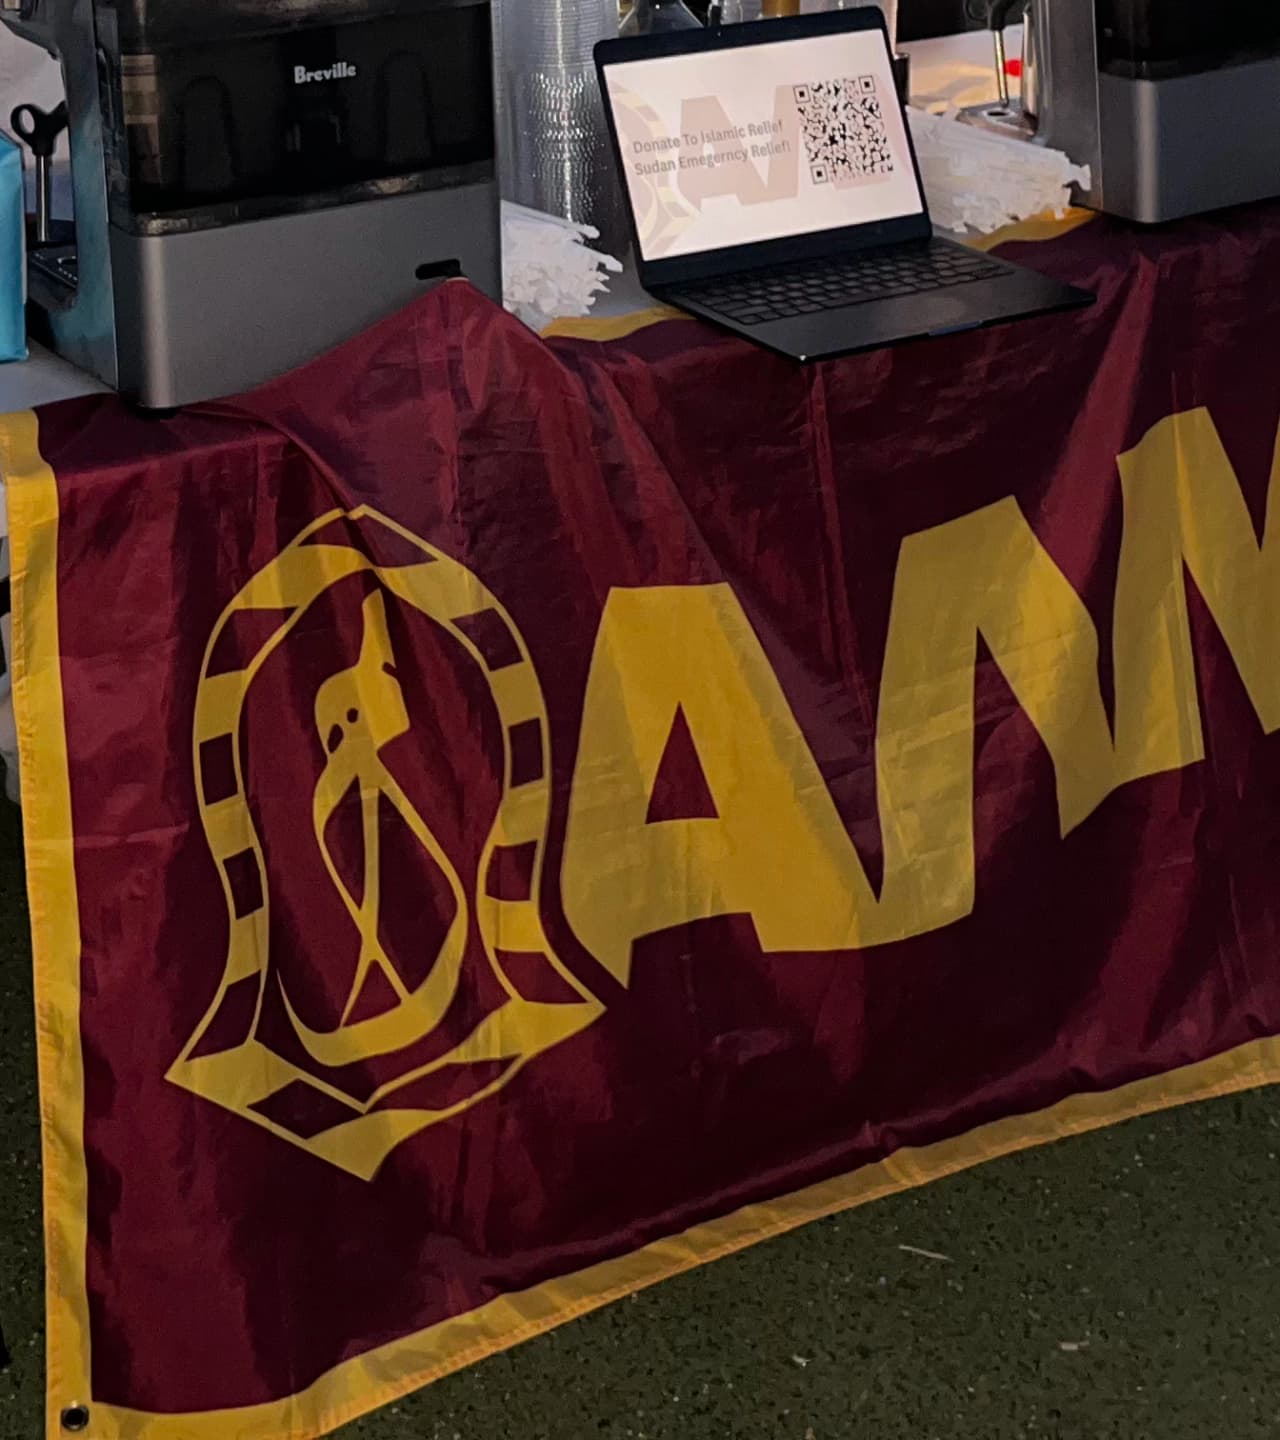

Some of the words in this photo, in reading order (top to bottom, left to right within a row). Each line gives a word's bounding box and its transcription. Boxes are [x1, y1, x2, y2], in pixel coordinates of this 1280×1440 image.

[294, 62, 357, 84] Breville
[633, 137, 680, 154] Donate
[681, 133, 698, 146] To
[702, 125, 746, 143] Islamic
[747, 120, 784, 137] Relief
[634, 160, 677, 176] Sudan
